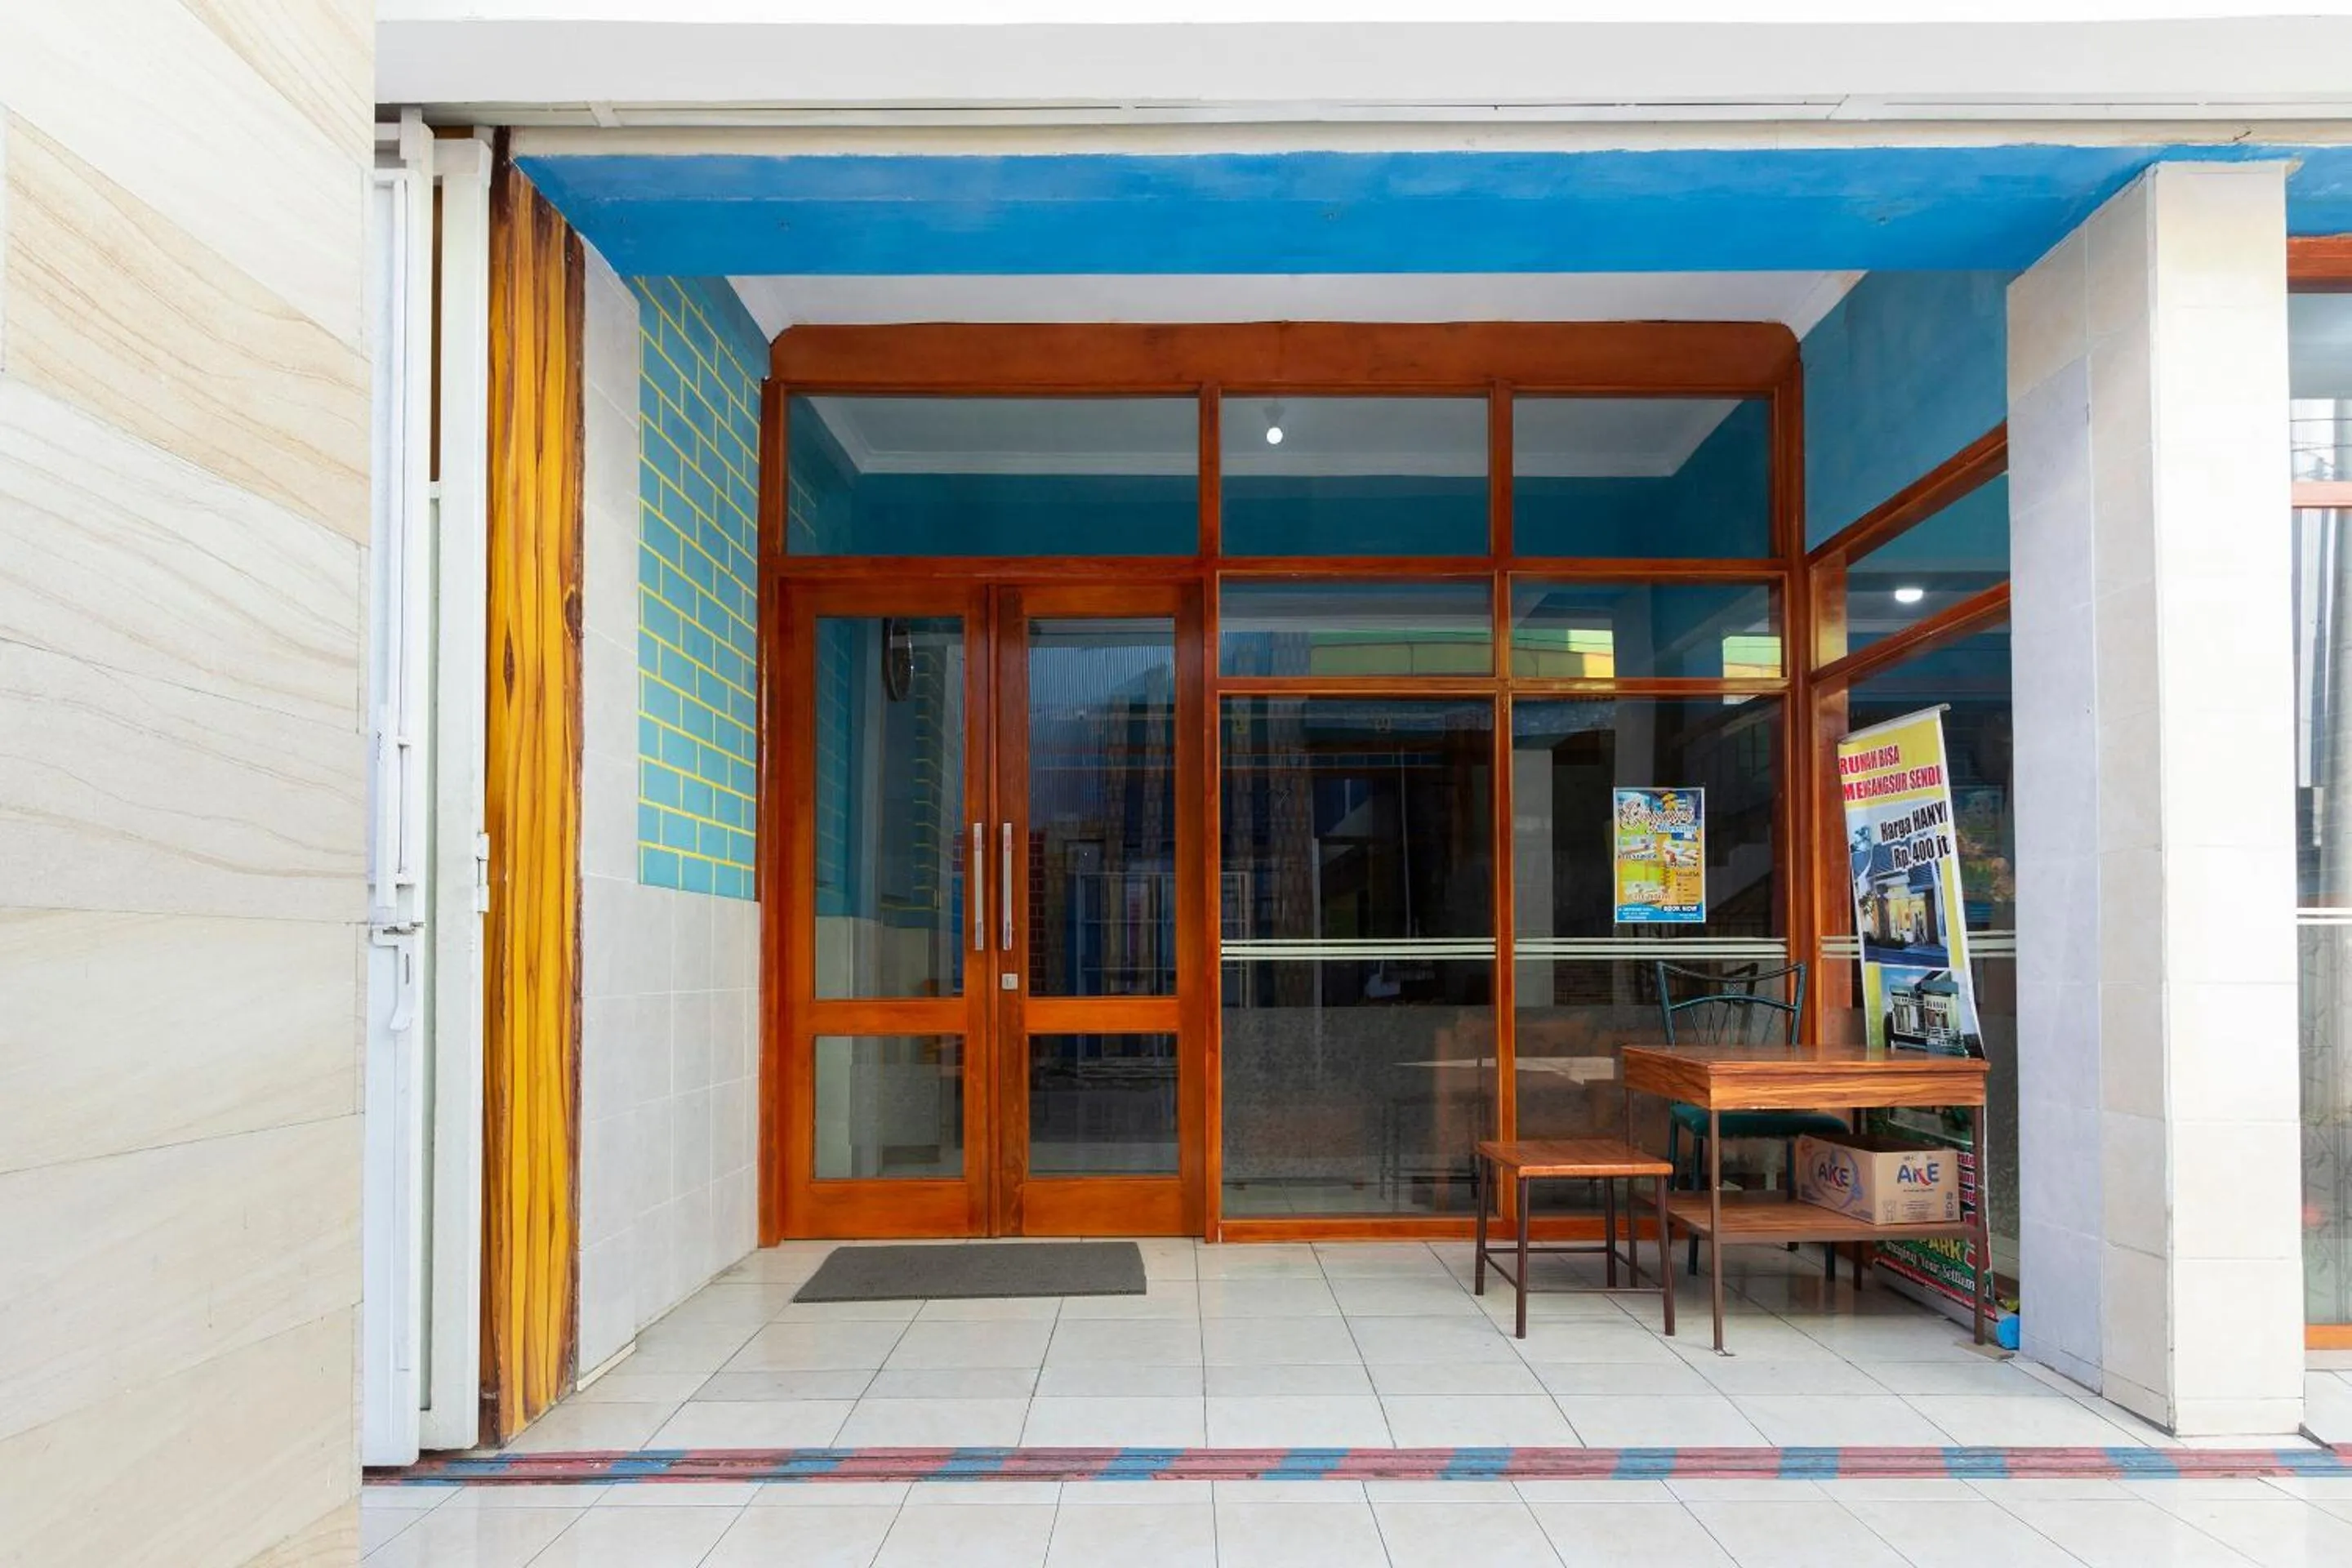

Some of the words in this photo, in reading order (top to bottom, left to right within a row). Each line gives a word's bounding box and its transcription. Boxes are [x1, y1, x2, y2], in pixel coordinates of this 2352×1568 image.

[1878, 744, 1900, 768] BISA
[1880, 816, 1912, 842] Harga
[1936, 835, 1950, 858] jt
[1818, 1162, 1850, 1187] AKE
[1896, 1163, 1940, 1186] AKE
